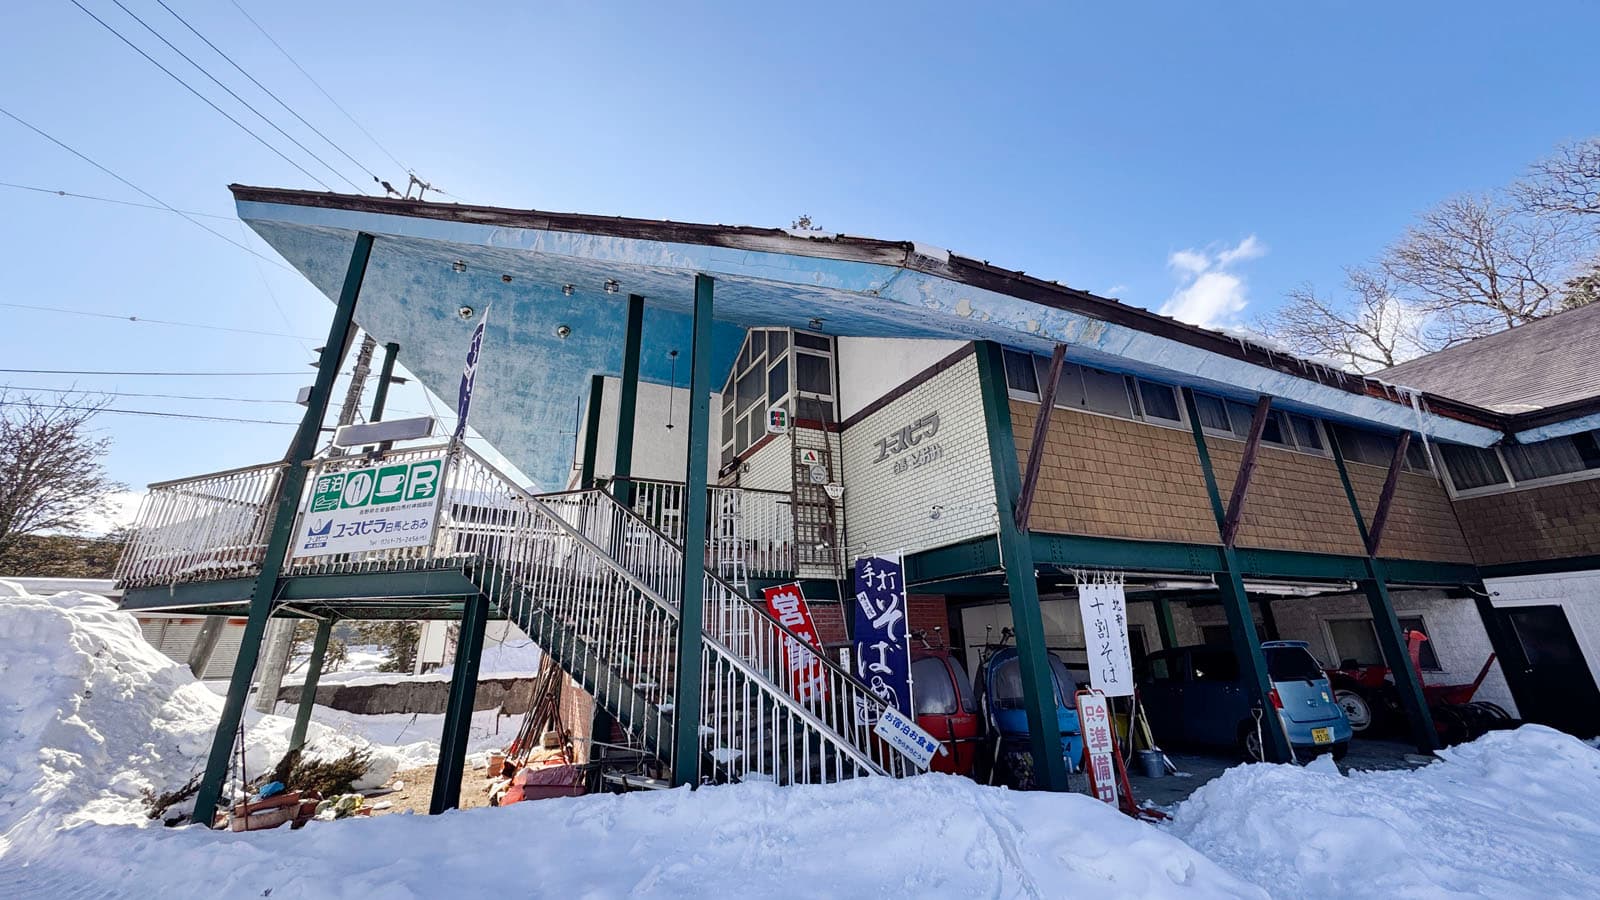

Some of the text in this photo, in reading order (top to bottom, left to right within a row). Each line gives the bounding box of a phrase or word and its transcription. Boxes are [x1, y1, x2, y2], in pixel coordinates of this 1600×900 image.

[317, 476, 343, 494] 宿泊
[861, 561, 897, 591] 手打
[857, 593, 903, 678] そば
[1090, 597, 1118, 683] 十割そば
[885, 712, 936, 753] お宿泊お食事
[1085, 705, 1104, 723] 只今
[1089, 726, 1114, 803] 準備中
